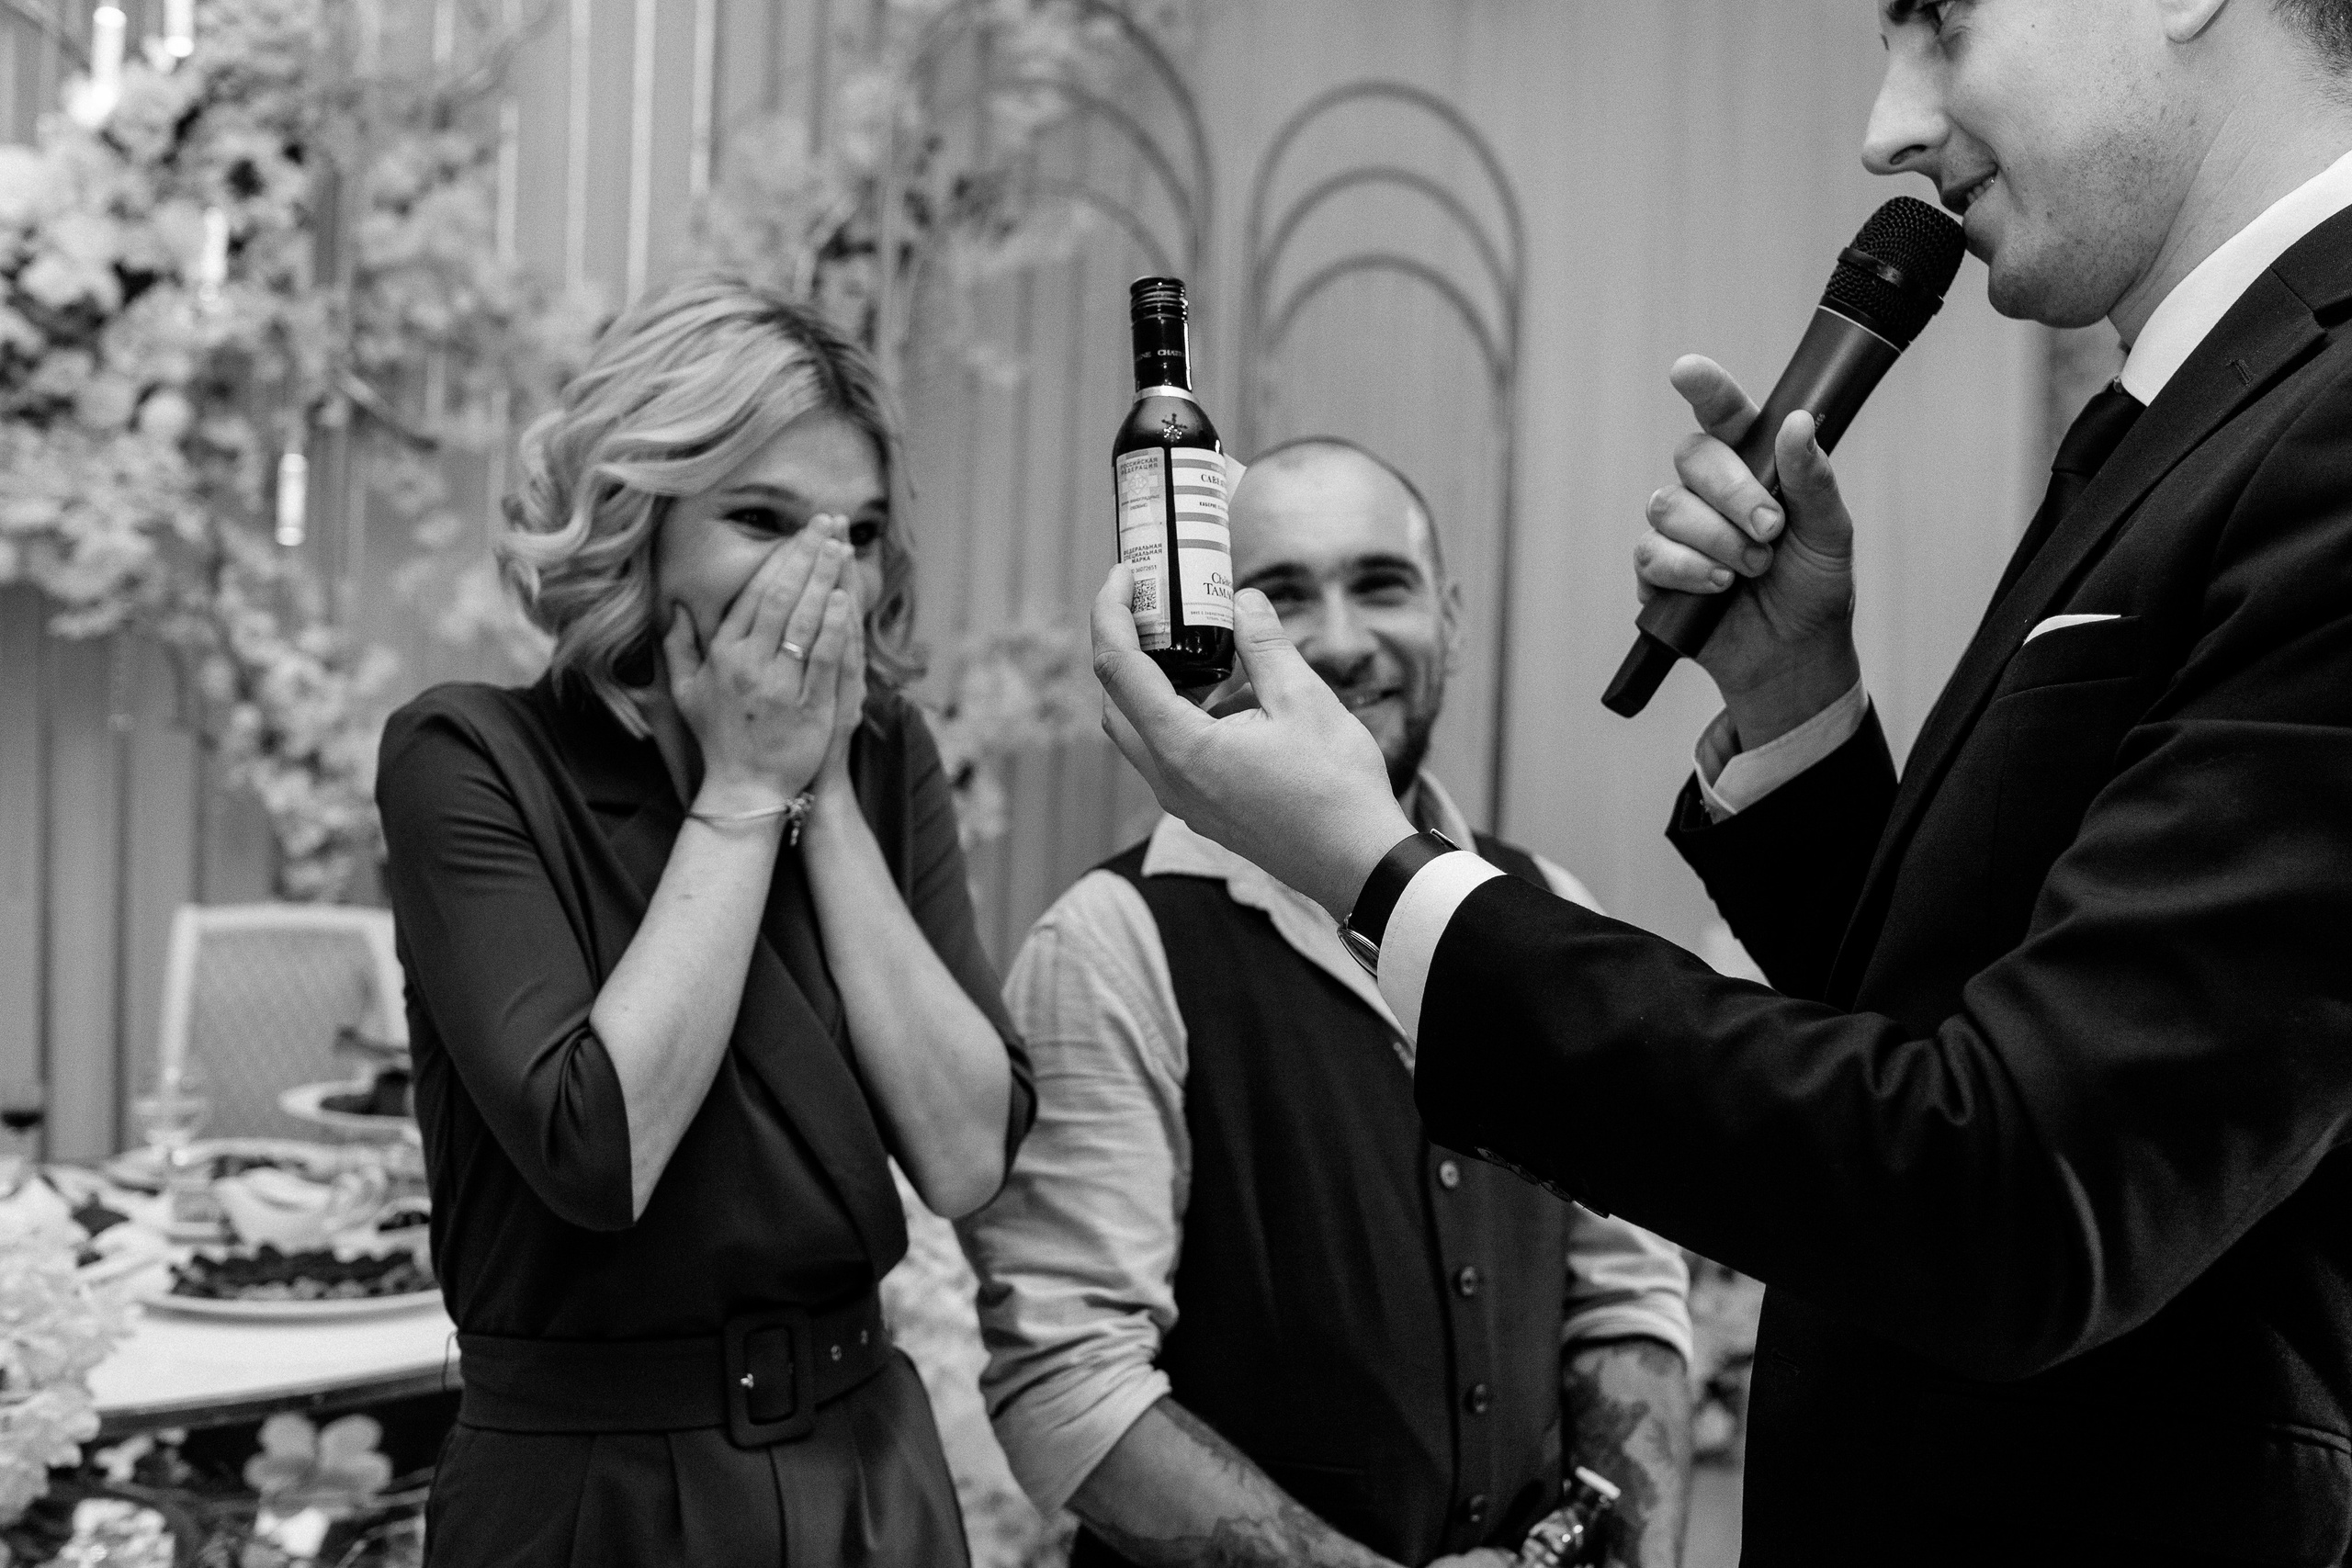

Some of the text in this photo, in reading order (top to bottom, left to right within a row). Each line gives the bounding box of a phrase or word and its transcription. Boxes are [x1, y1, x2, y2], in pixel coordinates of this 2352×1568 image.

[1120, 457, 1159, 469] РОССИЙСКАЯ
[1121, 463, 1159, 475] ФЕДЕРАЦИЯ
[1124, 543, 1162, 555] ФЕДЕРАЛЬНАЯ
[1124, 548, 1162, 561] СПЕЦИАЛЬНАЯ
